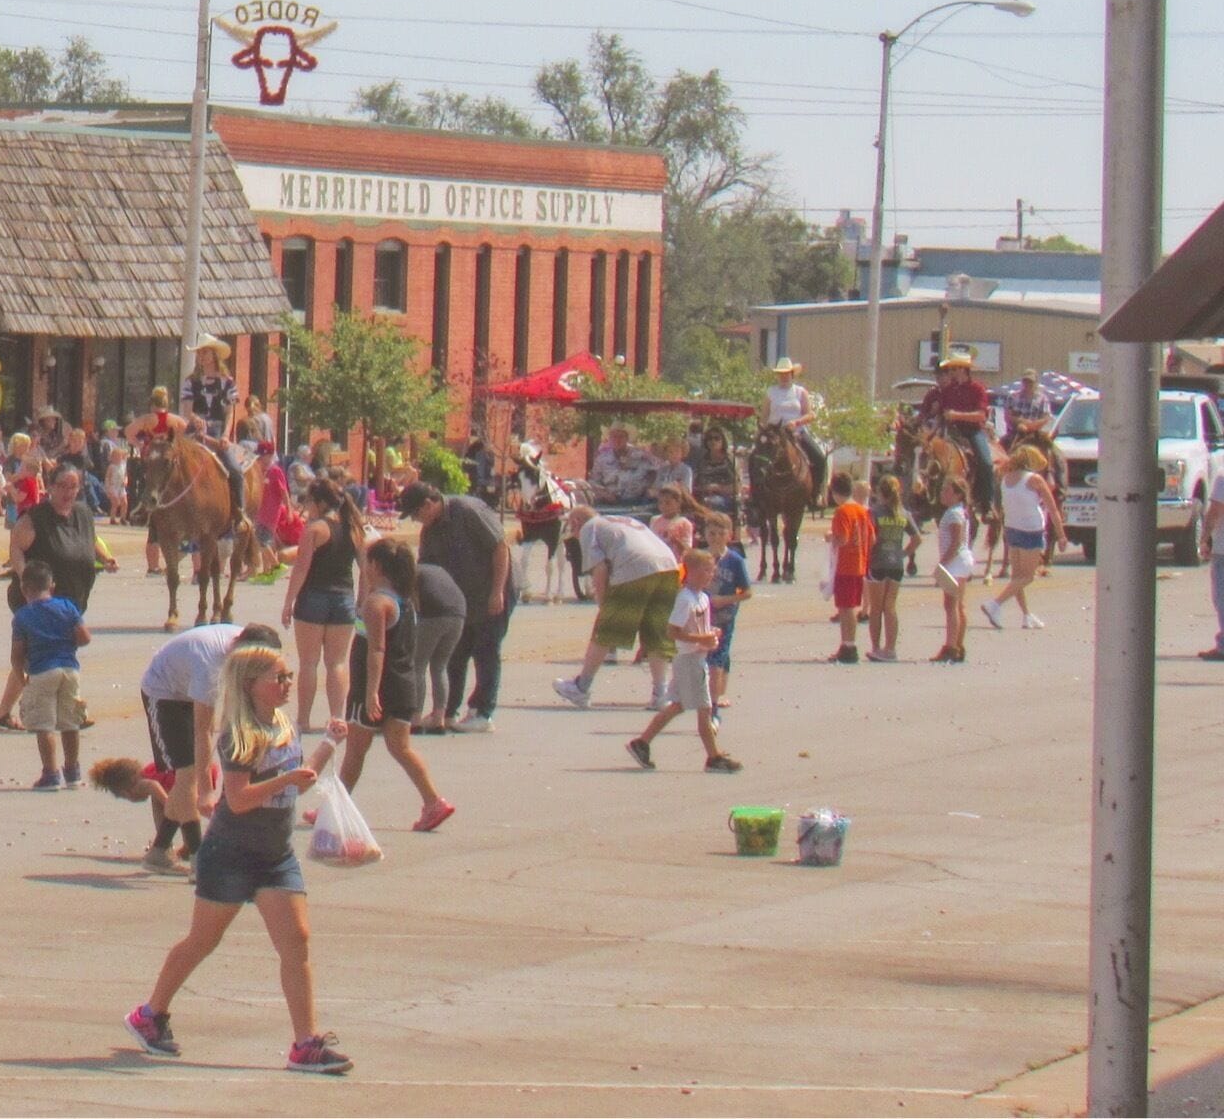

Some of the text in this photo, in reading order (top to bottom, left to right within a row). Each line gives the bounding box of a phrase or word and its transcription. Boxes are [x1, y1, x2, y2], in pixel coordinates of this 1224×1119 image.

[280, 172, 614, 225] MERRIFIELD OFFICE SUPPLY
